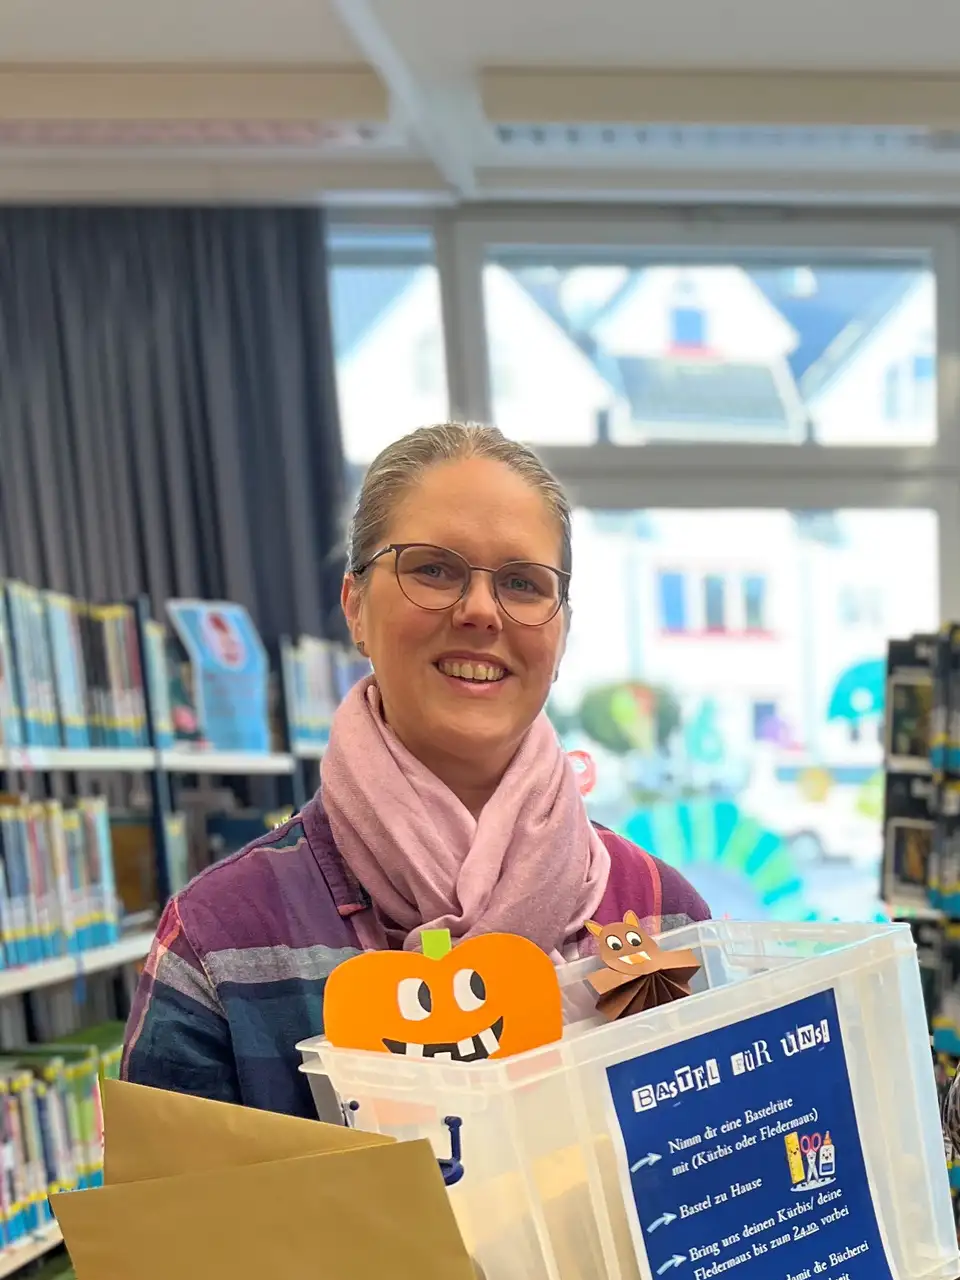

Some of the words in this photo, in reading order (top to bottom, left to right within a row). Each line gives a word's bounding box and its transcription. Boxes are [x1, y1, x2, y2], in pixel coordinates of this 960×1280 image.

[668, 1133, 702, 1153] Nimm
[704, 1125, 718, 1140] dir
[720, 1117, 742, 1134] eine
[744, 1098, 794, 1125] Basteltüte
[671, 1161, 690, 1177] mit
[691, 1144, 733, 1170] (Kürbis
[735, 1134, 757, 1151] oder
[759, 1107, 818, 1141] Fledermaus)
[679, 1195, 712, 1219] Bastel
[714, 1192, 728, 1205] zu
[730, 1177, 763, 1198] Hause
[688, 1242, 720, 1262] Bring
[722, 1232, 741, 1247] uns
[742, 1217, 776, 1238] deinen
[817, 1188, 843, 1206] deine
[752, 1243, 768, 1257] bis
[769, 1233, 791, 1249] zum
[820, 1205, 850, 1225] vorbei
[813, 1261, 828, 1274] die
[828, 1240, 870, 1267] Bücherei
